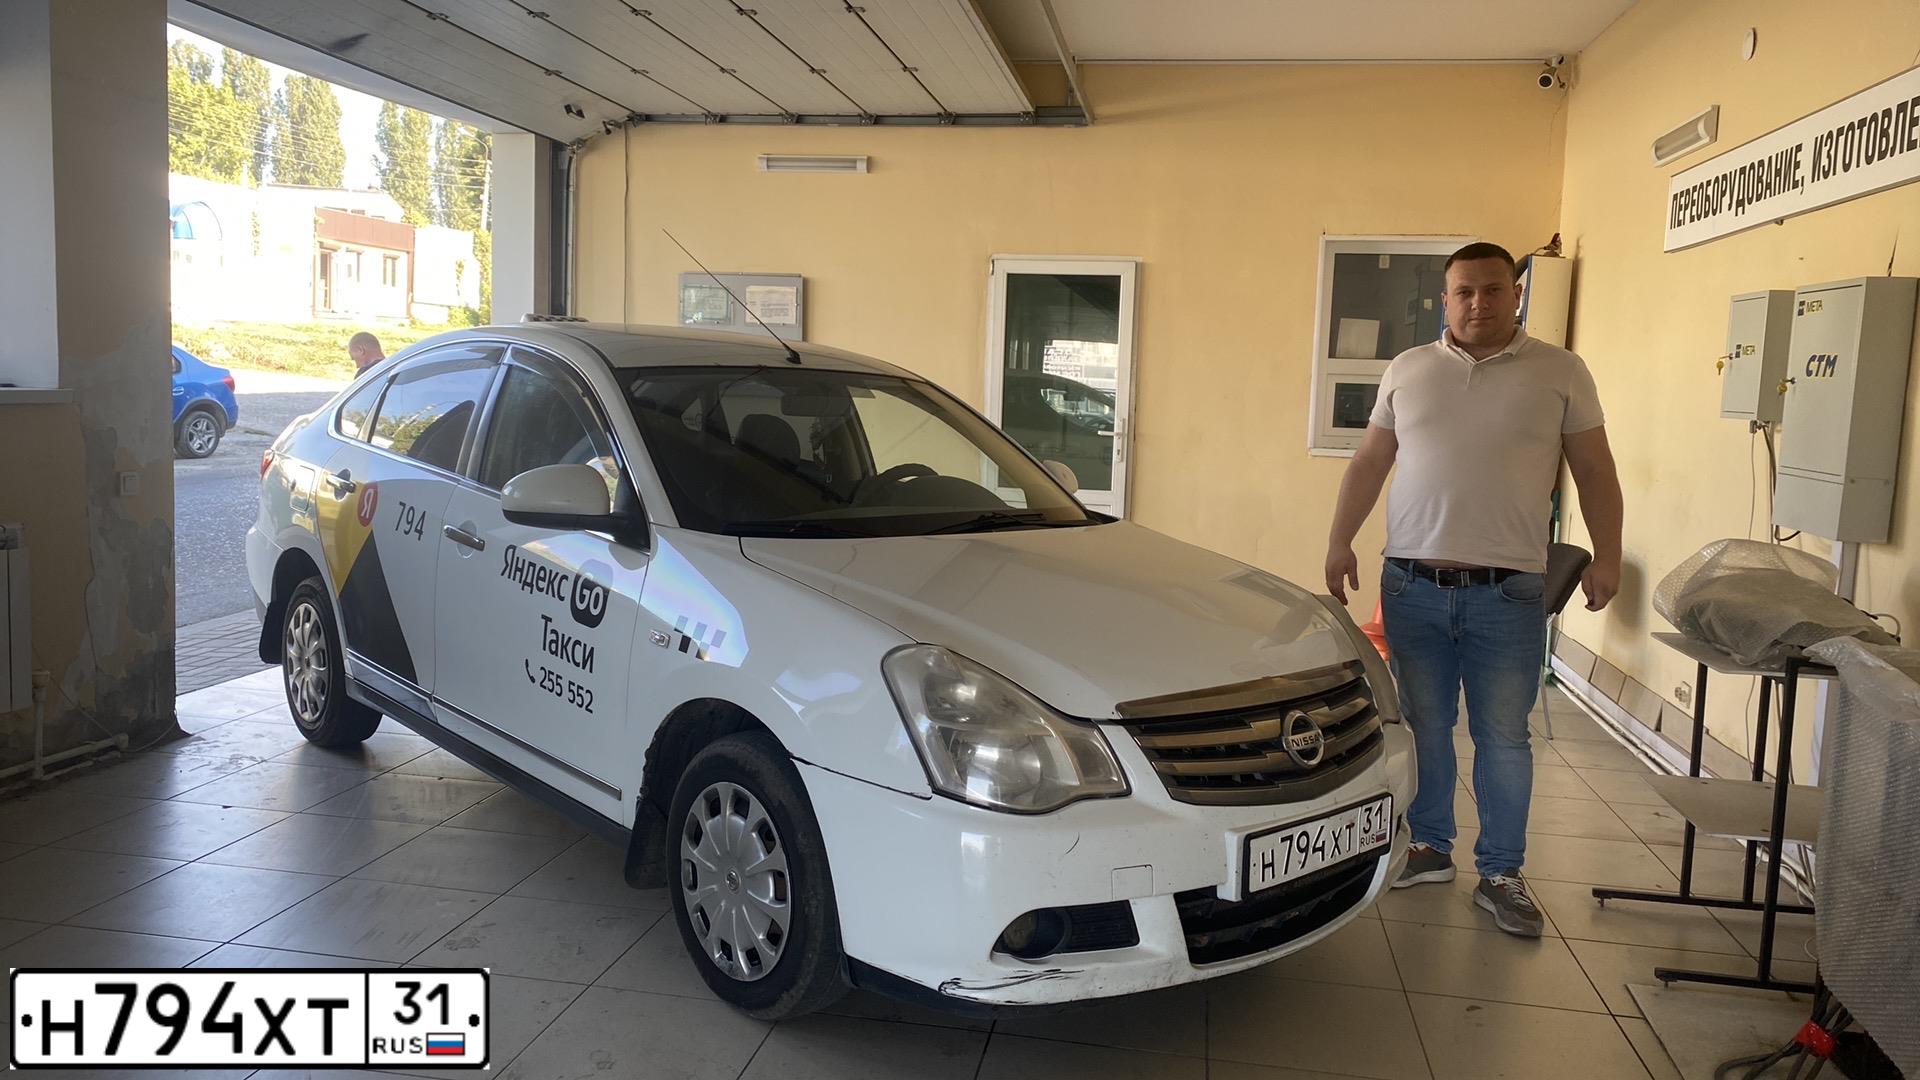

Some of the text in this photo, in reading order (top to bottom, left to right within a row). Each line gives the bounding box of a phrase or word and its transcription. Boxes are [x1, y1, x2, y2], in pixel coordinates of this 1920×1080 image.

[1670, 95, 1920, 229] ПЕРЕОБОРУДОВАНИЕ, ИЗГОТОВЛЕ
[1806, 354, 1838, 378] СТМ
[361, 488, 374, 519] Я
[395, 501, 426, 541] 794
[501, 544, 604, 616] Яндекс Go
[541, 614, 594, 674] Такси
[539, 666, 593, 714] 255 552
[1291, 732, 1322, 747] NISSA
[1363, 802, 1384, 834] 31
[1261, 822, 1355, 883] Н794ХТ
[1361, 834, 1376, 847] RUS
